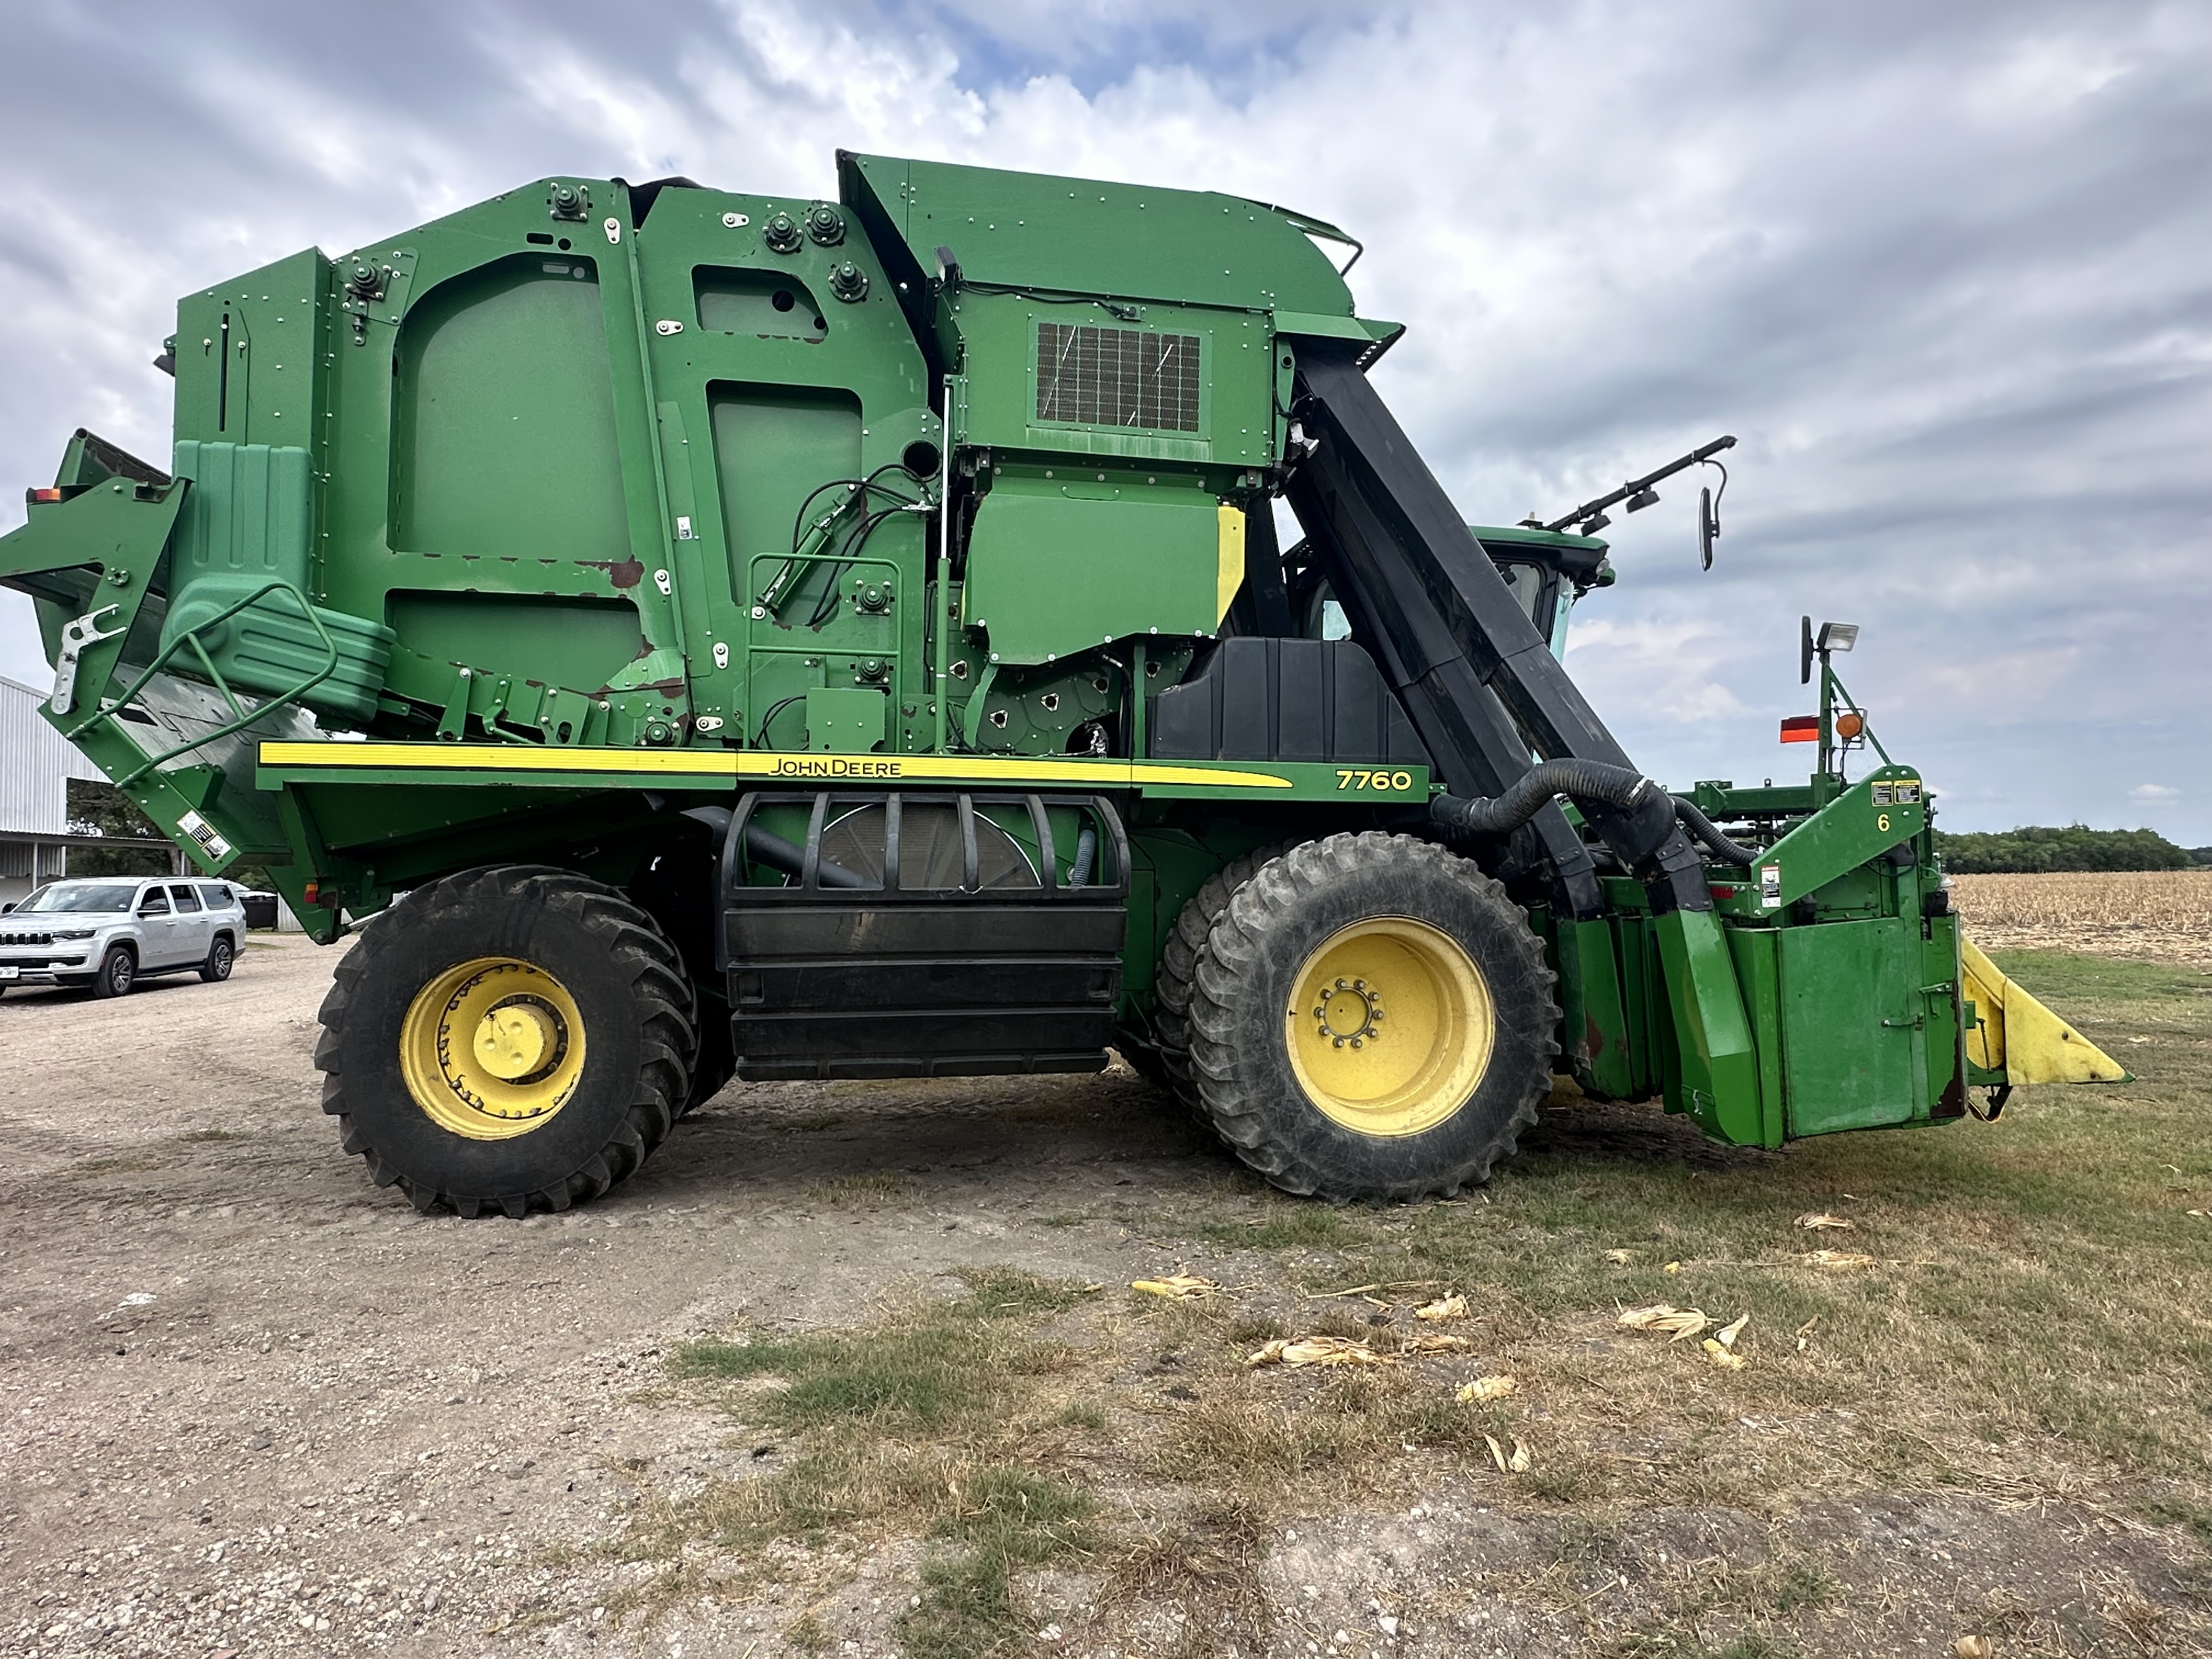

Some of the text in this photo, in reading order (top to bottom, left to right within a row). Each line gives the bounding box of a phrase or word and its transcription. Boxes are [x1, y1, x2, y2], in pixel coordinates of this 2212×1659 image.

[770, 758, 901, 775] JOHN DEERE
[1336, 770, 1412, 791] 7760
[1877, 814, 1890, 832] 6
